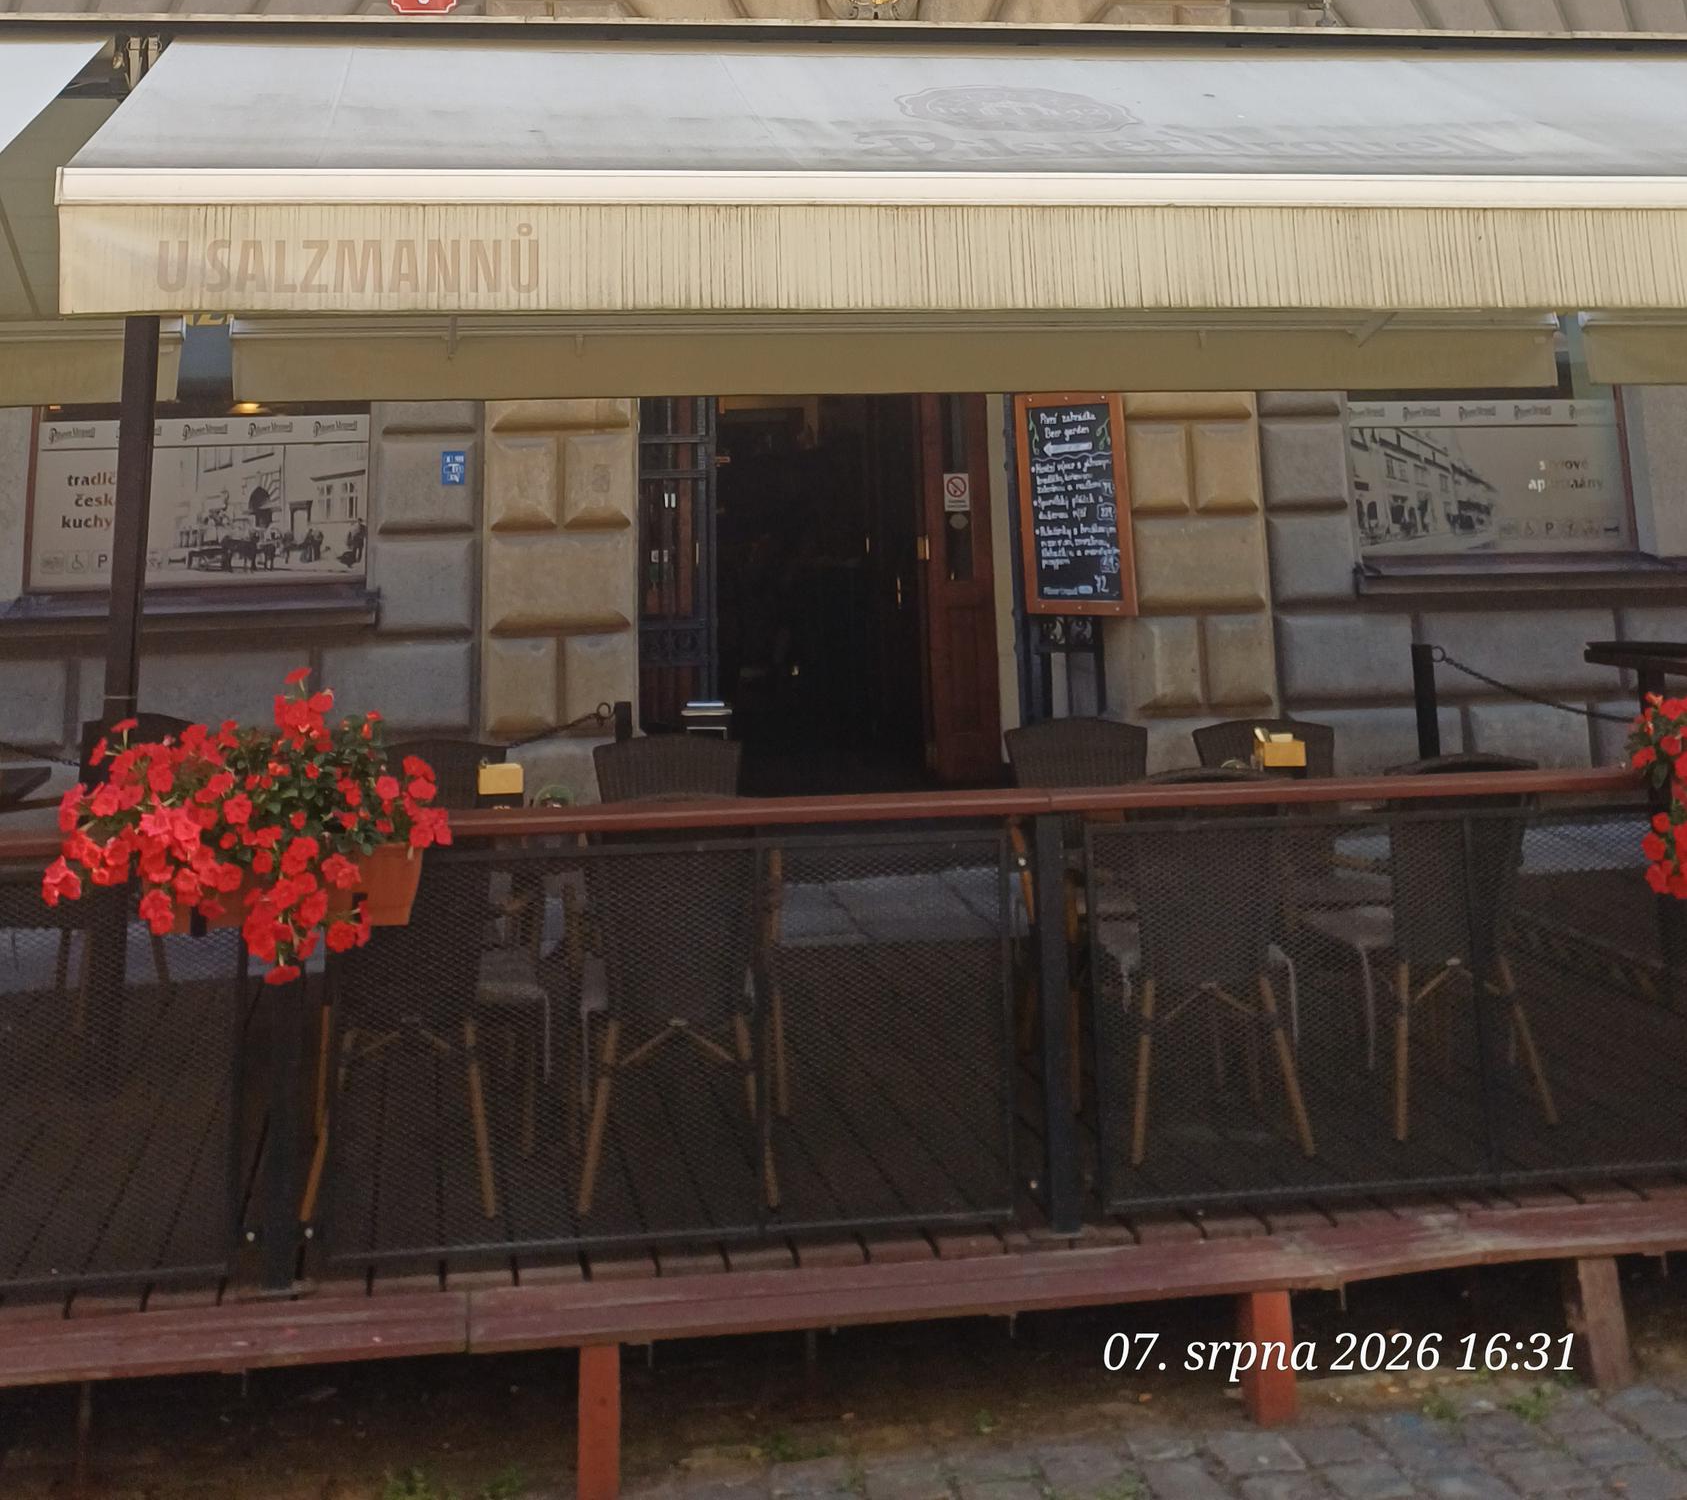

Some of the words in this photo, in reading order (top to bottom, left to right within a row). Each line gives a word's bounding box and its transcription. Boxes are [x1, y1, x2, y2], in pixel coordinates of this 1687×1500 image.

[156, 240, 189, 293] U
[205, 223, 540, 294] SALZMANNŮ
[67, 472, 116, 487] tradič
[75, 493, 113, 507] česk
[62, 515, 112, 530] kuchy
